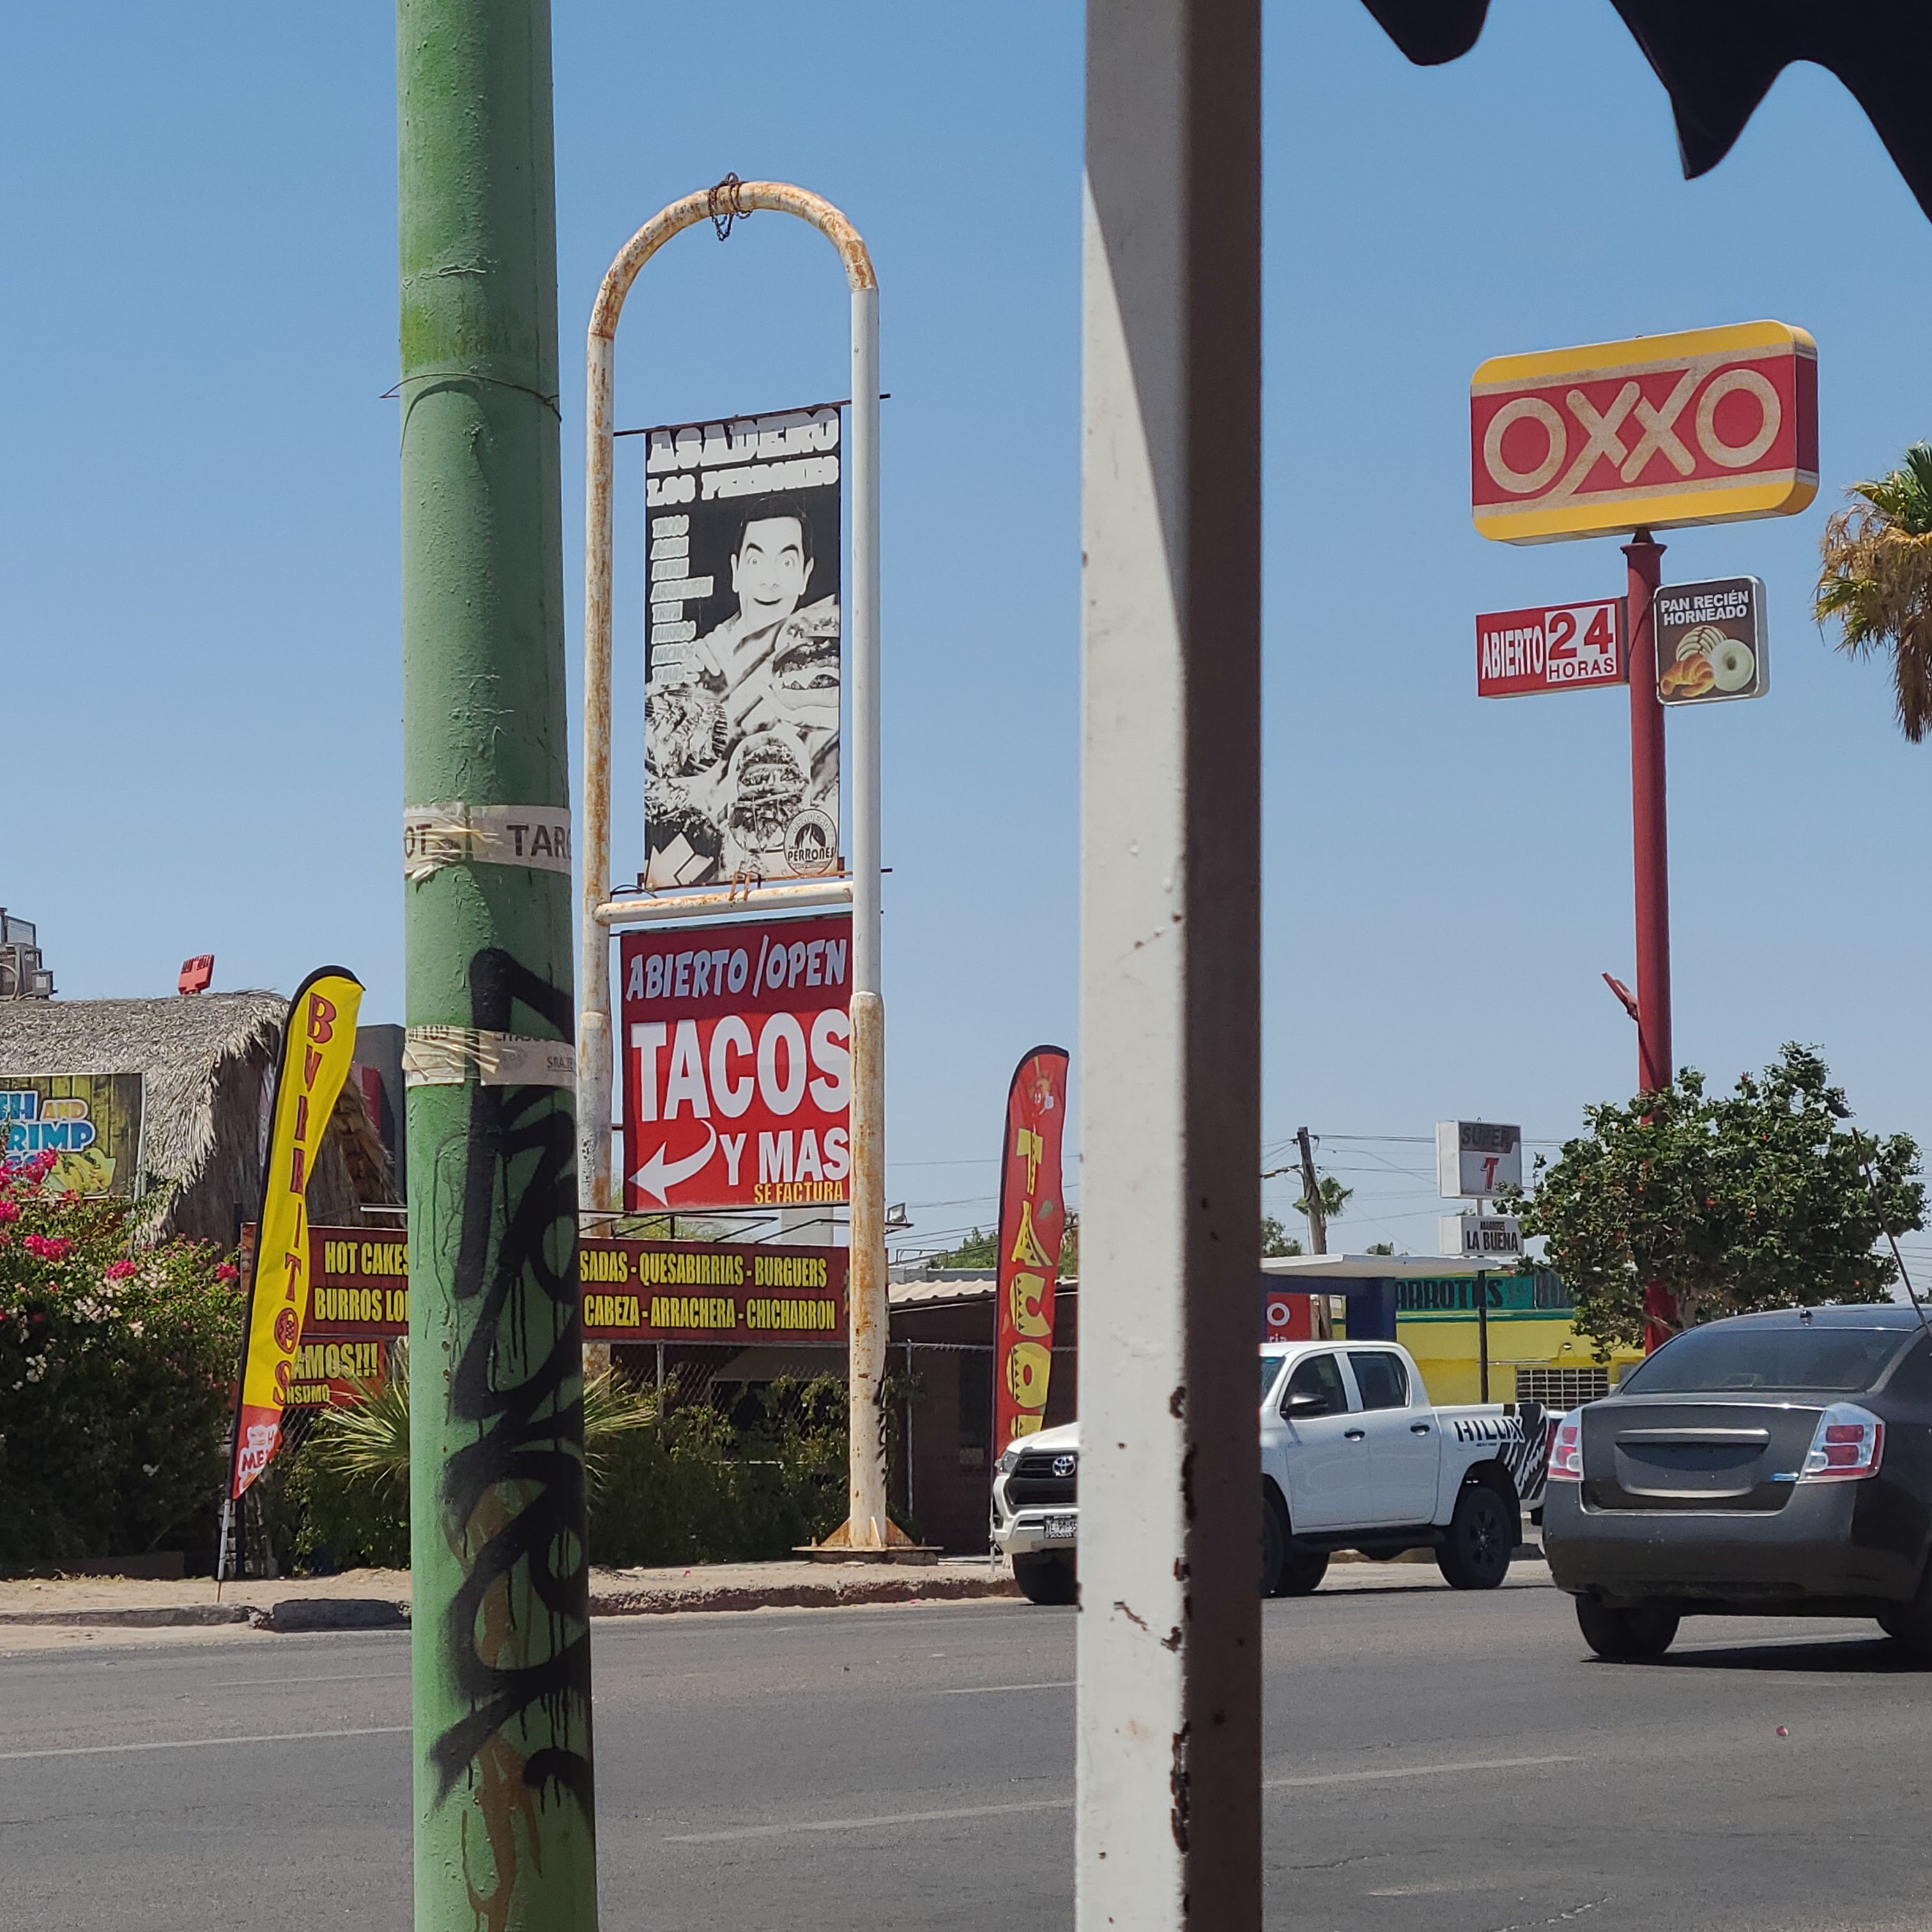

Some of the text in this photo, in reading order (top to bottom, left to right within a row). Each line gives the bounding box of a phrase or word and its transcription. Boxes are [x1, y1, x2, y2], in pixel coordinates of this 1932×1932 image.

[1483, 367, 1781, 498] OXXO
[1661, 589, 1749, 613] PAN RECIÉN
[1663, 606, 1747, 626] HORNEADO
[1482, 608, 1613, 679] ABIERTO 24
[1549, 658, 1614, 680] HORAS
[787, 846, 835, 862] PERRONES
[626, 948, 748, 1001] ABIERTO
[631, 1009, 850, 1122] TACOS
[42, 1100, 87, 1120] AND
[719, 1127, 850, 1186] Y MAS
[754, 1181, 843, 1204] SE FACTURA
[325, 1241, 358, 1274] HOT
[1467, 1230, 1519, 1252] LA BUENA
[640, 1252, 744, 1286] QUESABIRRIAS
[755, 1257, 827, 1288] BURGUERS
[314, 1288, 382, 1321] BURROS
[585, 1294, 835, 1330] CABEZA ARRACHERA CHICHARRON
[1453, 1419, 1525, 1442] HILUX
